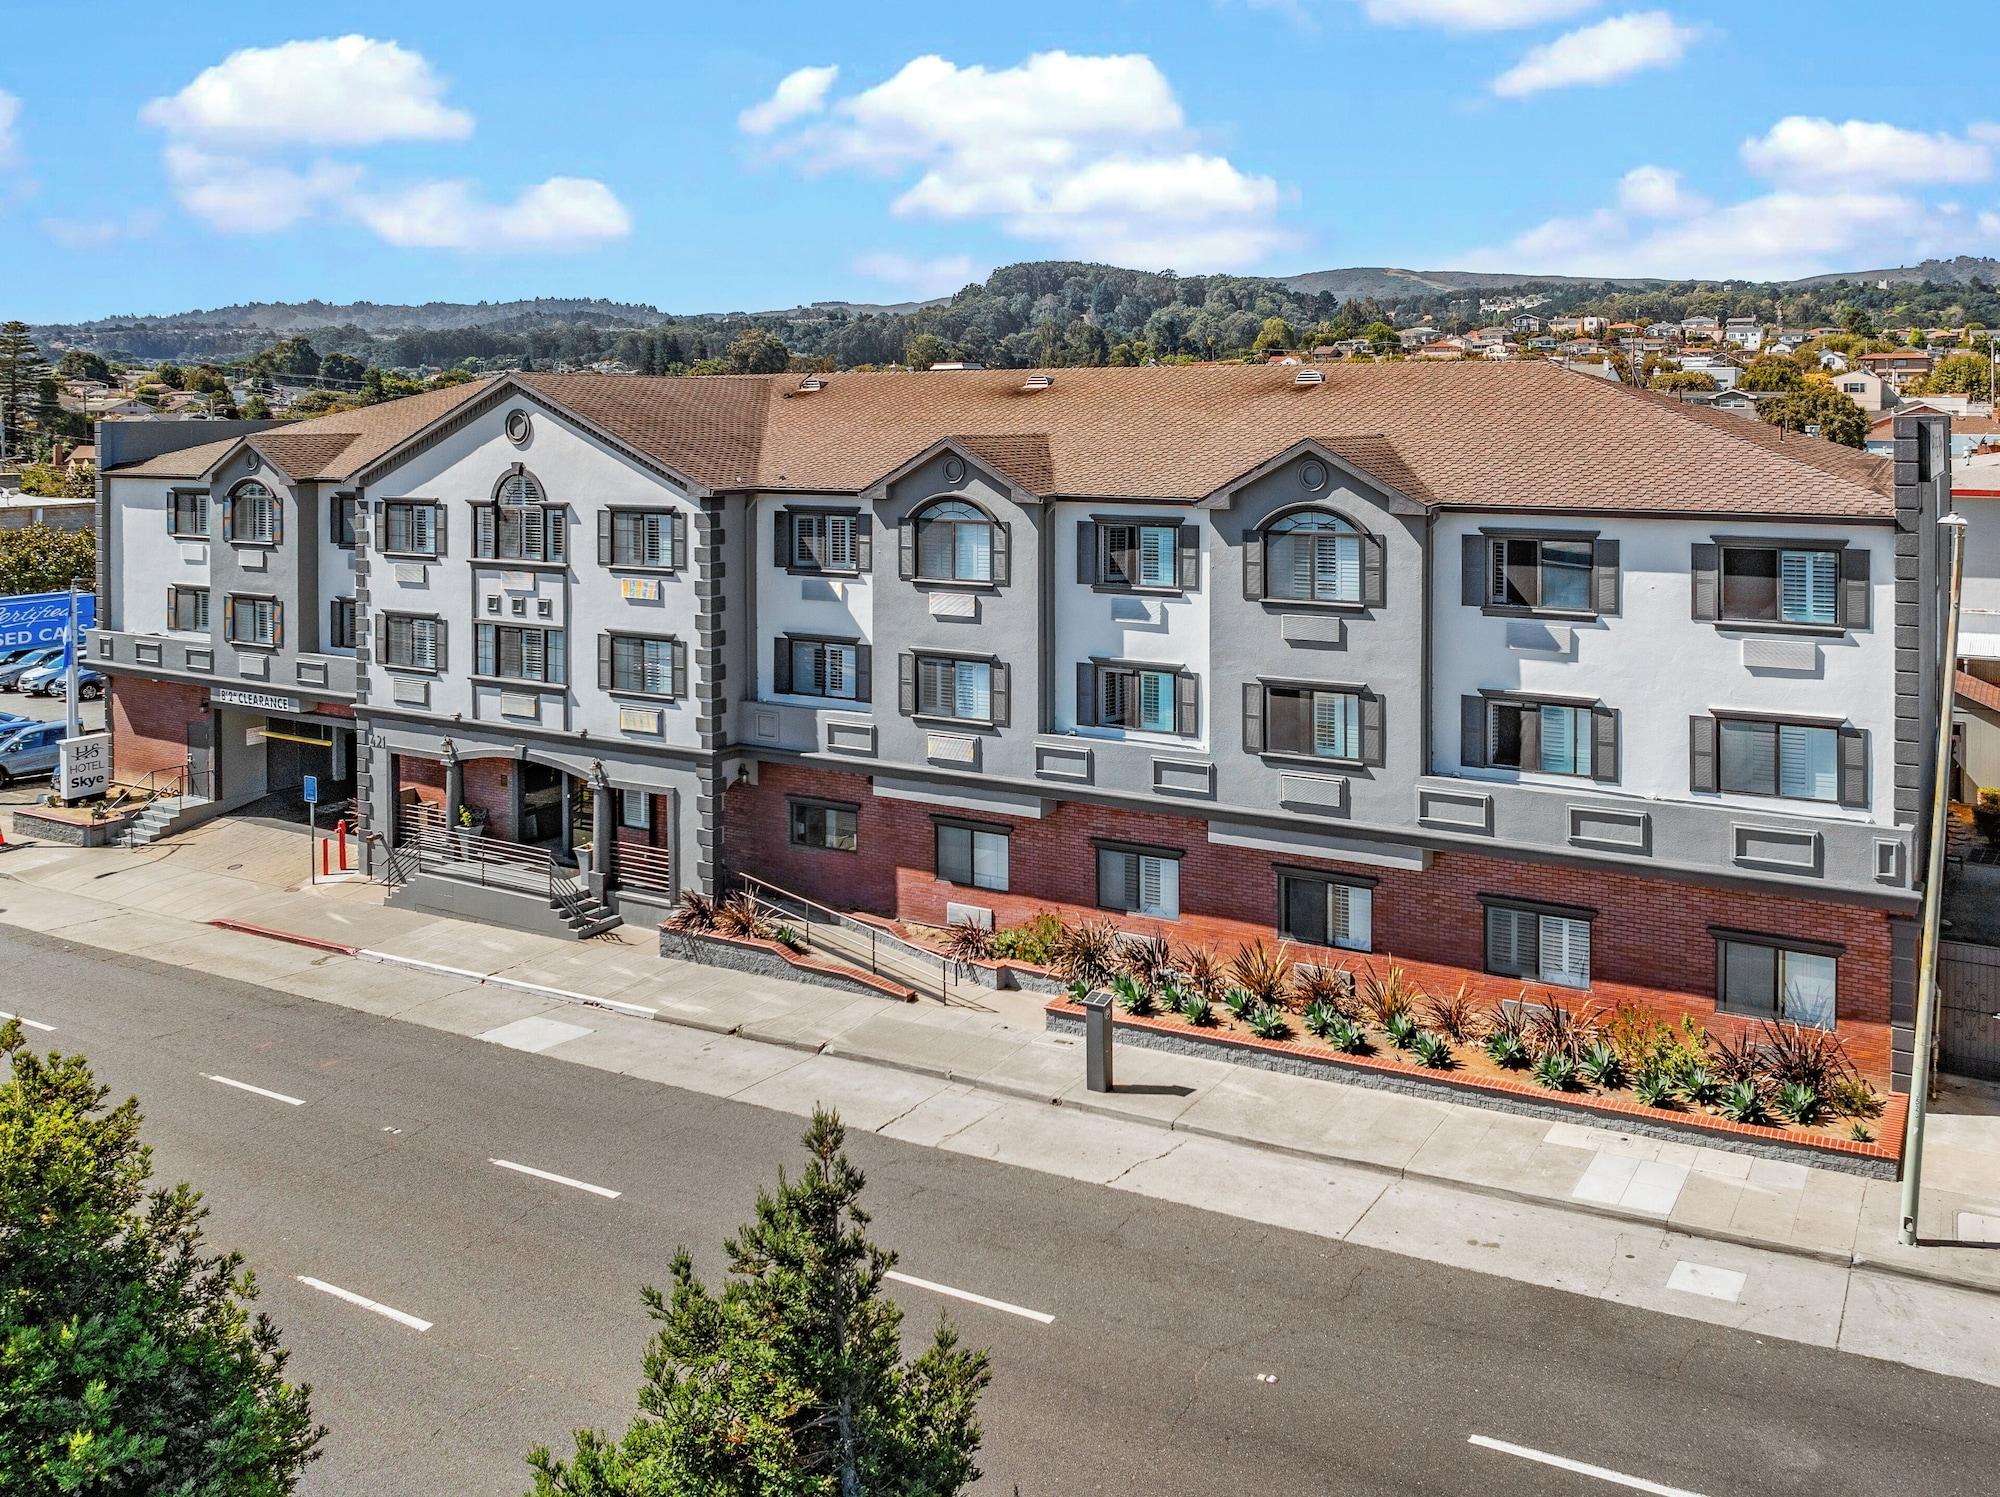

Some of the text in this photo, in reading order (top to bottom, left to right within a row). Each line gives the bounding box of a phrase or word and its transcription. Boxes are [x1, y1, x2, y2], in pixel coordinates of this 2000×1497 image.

[0, 624, 88, 646] SED CAS
[238, 693, 289, 710] CLEARANCE
[370, 734, 386, 749] 421
[70, 760, 104, 774] HOTEL
[71, 775, 104, 789] Skye
